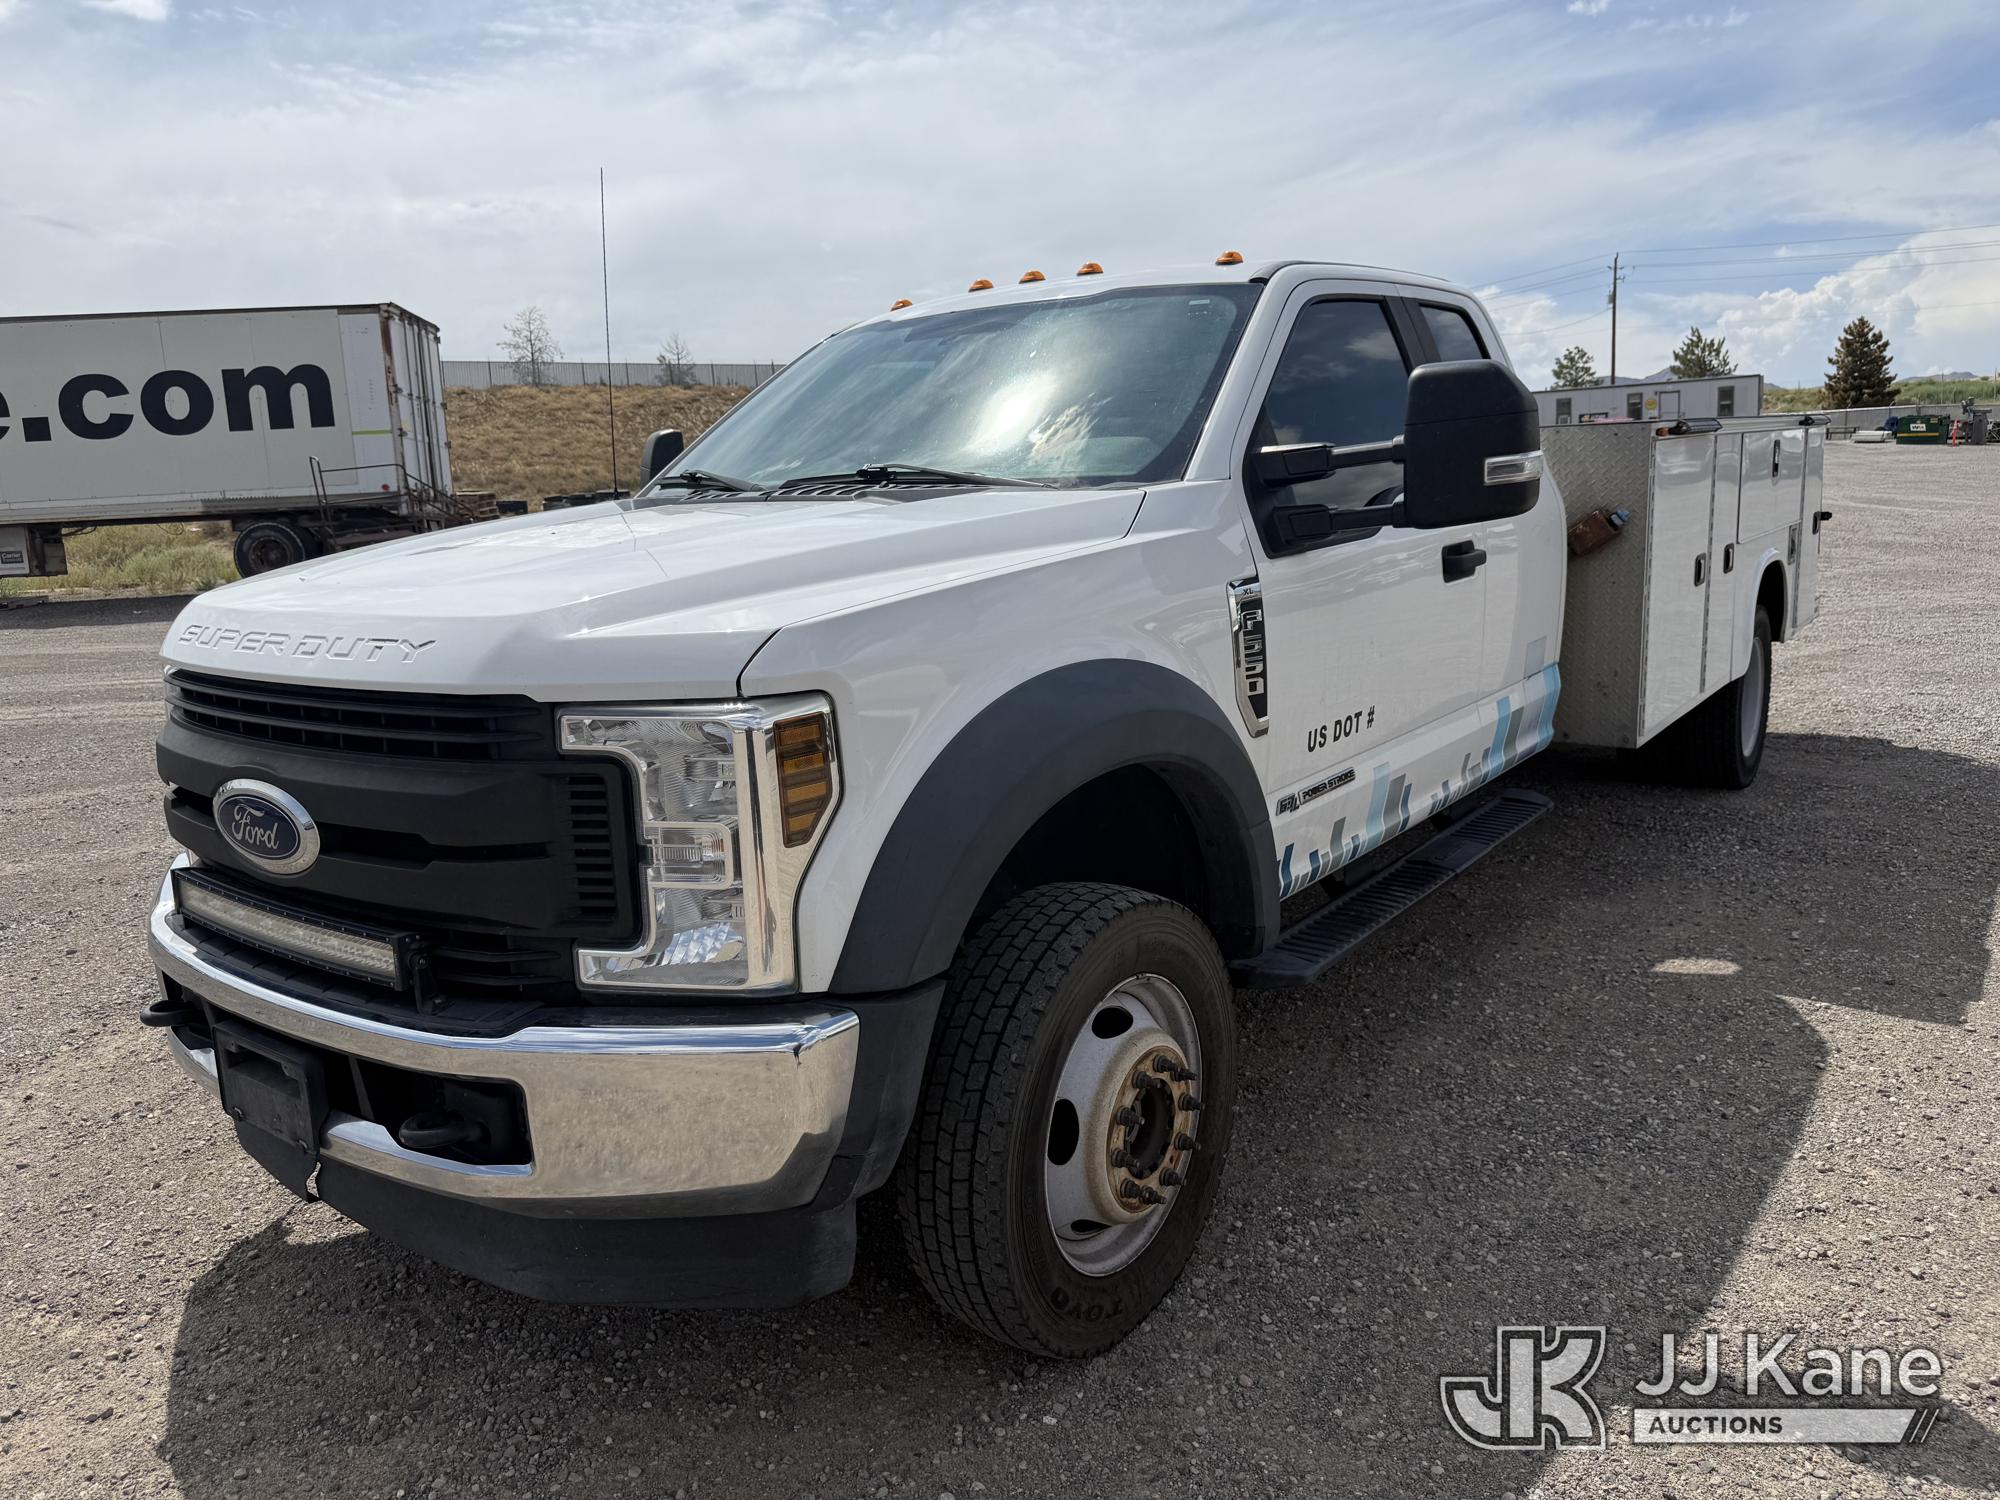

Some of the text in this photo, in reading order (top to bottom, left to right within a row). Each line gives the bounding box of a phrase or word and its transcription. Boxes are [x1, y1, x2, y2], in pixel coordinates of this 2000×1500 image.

[0, 363, 336, 443] .com
[1243, 587, 1254, 596] XL
[177, 624, 438, 664] SUPER DUTY
[1307, 705, 1376, 753] US DOT #
[1302, 781, 1328, 800] POWER
[1328, 768, 1356, 788] STROKE
[231, 803, 280, 850] Ford
